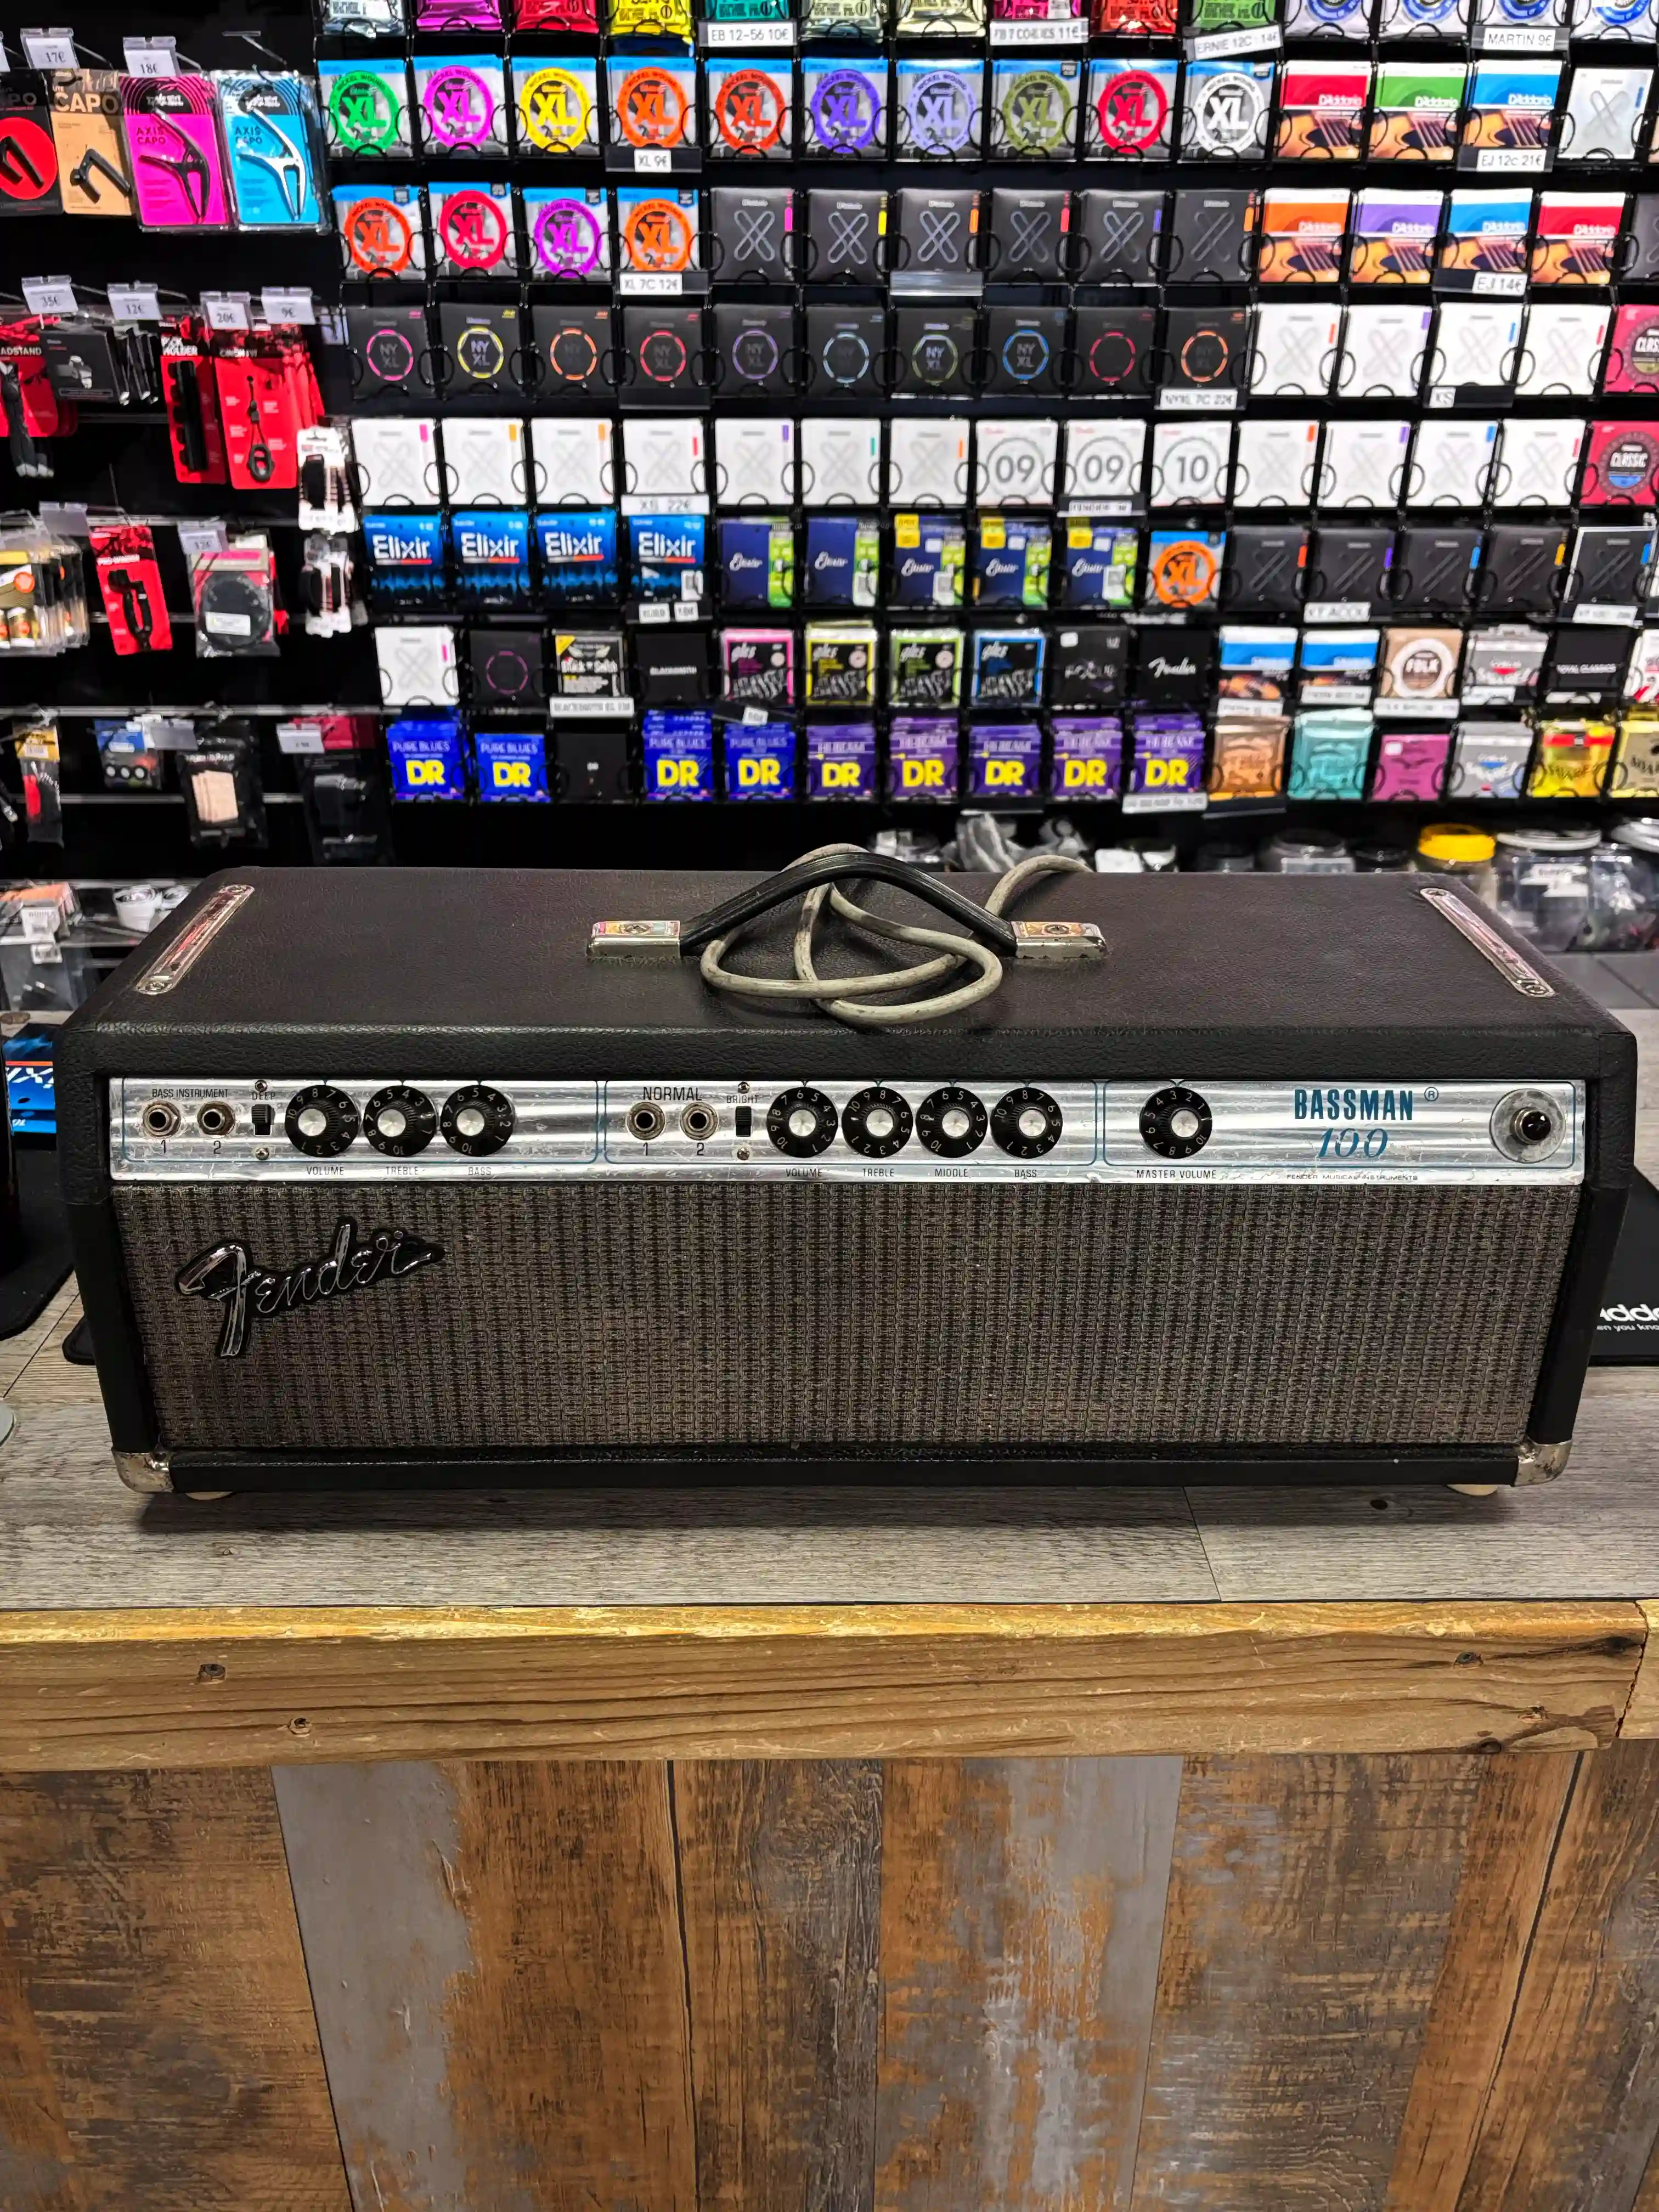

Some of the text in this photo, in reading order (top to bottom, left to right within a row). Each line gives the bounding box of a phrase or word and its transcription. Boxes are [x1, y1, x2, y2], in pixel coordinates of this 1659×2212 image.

[712, 29, 788, 41] EB 12-56 10€
[1059, 27, 1079, 38] 11€
[1488, 33, 1553, 46] MARTIN 9€
[46, 52, 66, 63] 17€
[140, 63, 158, 74] 18€
[54, 91, 119, 114] CAPO
[437, 92, 481, 123] XL
[534, 93, 578, 126] XL
[631, 93, 675, 126] XL
[342, 96, 387, 128] XL
[730, 95, 772, 127] XL
[824, 95, 868, 128] XL
[921, 95, 962, 128] XL
[1018, 95, 1058, 128] XL
[1111, 95, 1152, 128] XL
[1207, 97, 1248, 131] XL
[136, 127, 164, 135] AXIS
[235, 127, 262, 136] AXIS
[137, 137, 166, 145] CAPO
[639, 155, 668, 167] XL 9€
[1482, 155, 1543, 167] EJ 12c 21€
[357, 221, 400, 252] XL
[452, 215, 494, 244] XL
[547, 222, 589, 253] XL
[633, 221, 679, 254] XL
[641, 279, 656, 289] 7C
[660, 279, 678, 289] 12€
[1478, 277, 1521, 292] EJ 14€
[380, 343, 398, 356] NY
[470, 340, 490, 353] NY
[1017, 342, 1037, 356] NY
[382, 356, 401, 368] XL
[472, 353, 490, 366] XL
[1017, 356, 1035, 368] XL
[1609, 452, 1648, 468] CLASSIC
[995, 454, 1035, 484] 09
[1084, 454, 1124, 484] 09
[1177, 455, 1210, 484] 10
[372, 533, 430, 560] Elixir
[460, 532, 520, 558] Elixir
[544, 532, 602, 557] Elixir
[639, 532, 696, 558] Elixir
[1166, 560, 1203, 587] XL
[1147, 657, 1196, 678] Fender
[406, 760, 445, 785] DR
[493, 762, 531, 787] DR
[656, 759, 699, 787] DR
[737, 759, 780, 786] DR
[822, 762, 861, 787] DR
[901, 760, 945, 787] DR
[985, 761, 1025, 787] DR
[1064, 760, 1107, 787] DR
[1145, 760, 1189, 787] DR
[152, 1088, 228, 1098] BASS INSTRUMENT
[252, 1091, 275, 1101] DEEP
[642, 1087, 703, 1101] NORMAL
[727, 1094, 758, 1104] BRIGHT
[1006, 1096, 1014, 1104] 9
[1022, 1090, 1028, 1100] 8
[1036, 1093, 1045, 1101] 7
[1170, 1090, 1177, 1100] 3
[1186, 1092, 1193, 1102] 2
[1156, 1098, 1164, 1106] 4
[1294, 1088, 1413, 1120] BASSMAN
[995, 1108, 1007, 1119] 10
[1047, 1135, 1055, 1143] 4
[1153, 1141, 1165, 1149] 7
[1196, 1135, 1207, 1146] 10
[1318, 1128, 1389, 1158] 100
[160, 1139, 222, 1154] 1 2
[642, 1142, 704, 1156] 1 2
[1021, 1147, 1028, 1156] 2
[1037, 1144, 1044, 1153] 3
[1169, 1146, 1176, 1155] 8
[1185, 1146, 1192, 1154] 9
[306, 1166, 344, 1176] VOLUME
[386, 1166, 419, 1176] TREBLE
[468, 1166, 492, 1176] BASS
[786, 1167, 822, 1178] VOLUME
[862, 1167, 895, 1177] TREBLE
[934, 1168, 969, 1178] MIDDLE
[1014, 1169, 1037, 1178] BASS
[1137, 1170, 1217, 1179] MASTER VOLUME
[177, 1222, 433, 1357] Fender
